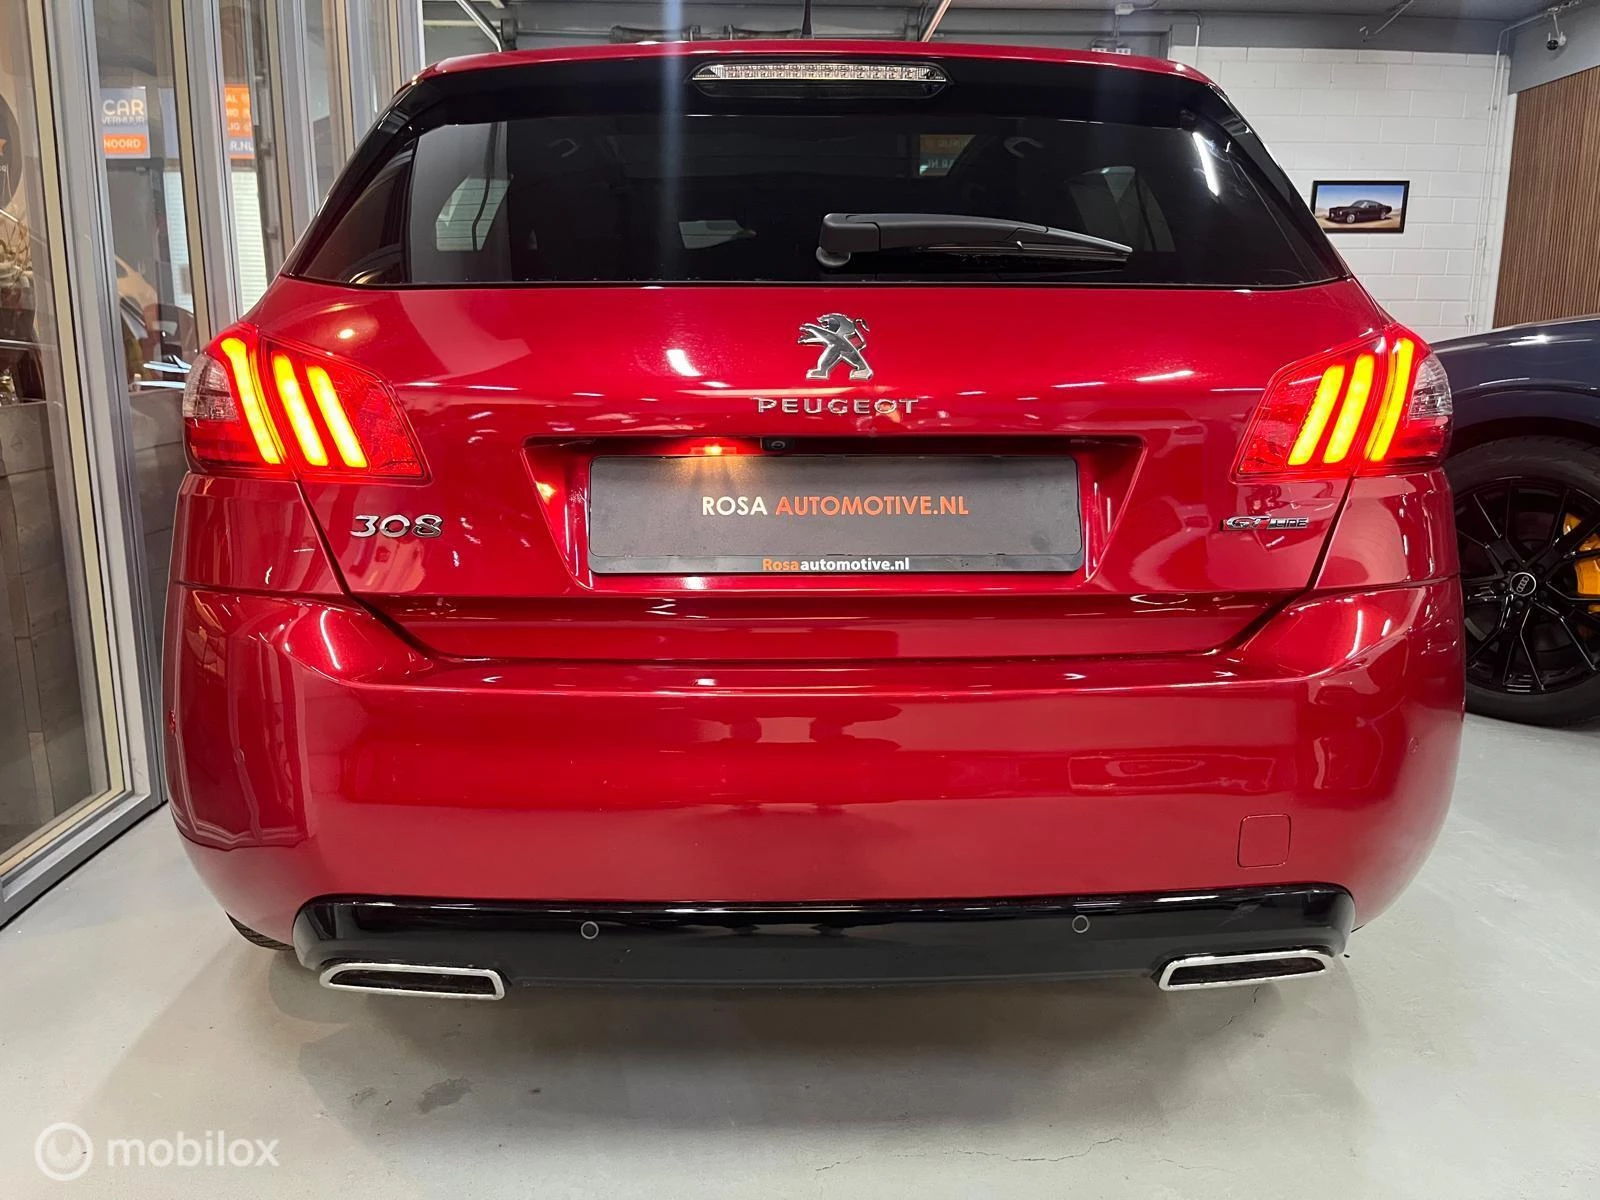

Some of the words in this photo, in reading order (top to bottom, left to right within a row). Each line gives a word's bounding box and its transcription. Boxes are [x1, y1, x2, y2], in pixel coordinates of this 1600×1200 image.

[102, 99, 145, 116] CAR
[756, 397, 919, 414] PEUGEOT
[702, 495, 768, 517] ROSA
[775, 495, 969, 517] AUTOMOTIVE.NL
[349, 513, 443, 538] 308
[1226, 515, 1271, 530] GT
[762, 557, 911, 572] Rosaautomotive.nl
